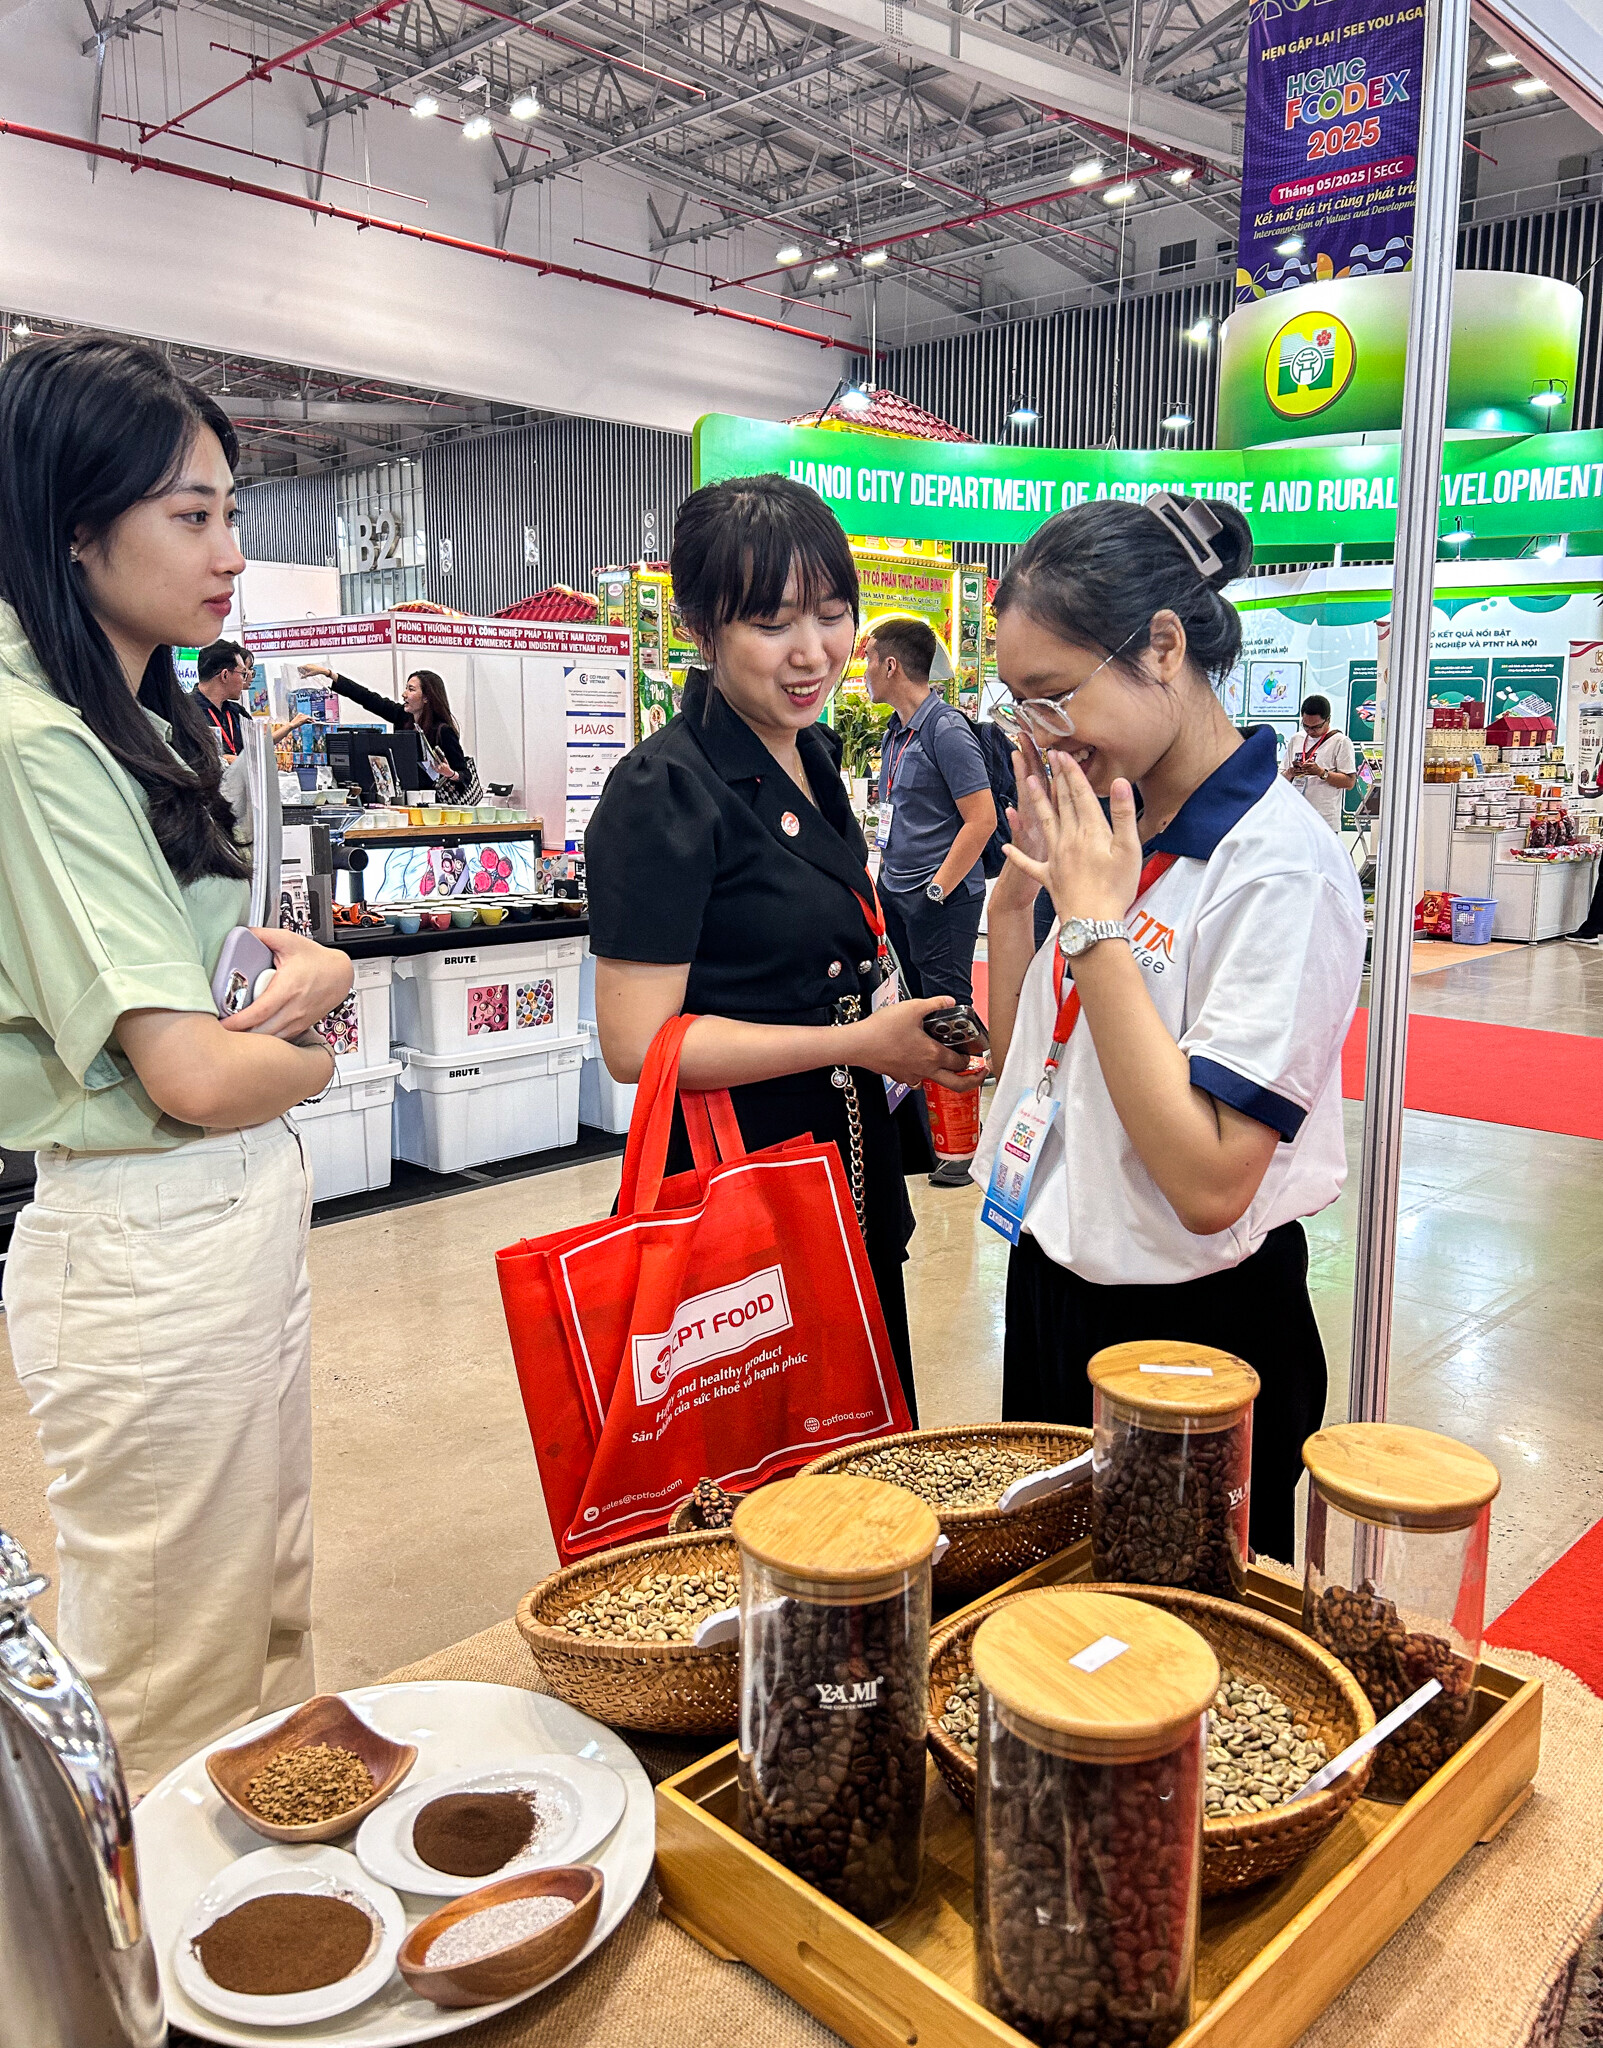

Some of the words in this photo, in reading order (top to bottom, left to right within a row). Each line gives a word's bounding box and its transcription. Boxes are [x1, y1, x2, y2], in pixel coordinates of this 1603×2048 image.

[1262, 44, 1285, 61] HẸN
[1288, 37, 1313, 52] GẶP
[1316, 32, 1335, 47] LẠI
[1343, 21, 1365, 38] SEE
[1368, 14, 1394, 34] YOU
[1286, 57, 1366, 99] HCMC
[1307, 116, 1380, 161] 2025
[1278, 183, 1314, 200] Tháng
[1316, 172, 1365, 191] 05/2025
[1374, 161, 1404, 178] SECC
[1254, 210, 1273, 227] Kết
[1296, 204, 1314, 220] giá
[1334, 194, 1363, 209] cùng
[1366, 185, 1395, 203] phát
[1254, 219, 1313, 240] Interconnection
[1314, 216, 1324, 227] of
[1326, 211, 1351, 224] Values
[1353, 208, 1370, 219] and
[790, 460, 852, 500] HANOI
[858, 468, 905, 504] CITY
[910, 472, 1056, 512] DEPARTMENT
[1061, 481, 1090, 511] OF
[1260, 480, 1312, 512] AND
[1317, 477, 1398, 512] RURAL
[356, 510, 401, 572] B2
[863, 570, 871, 584] TY
[397, 620, 422, 632] PHÒNG
[453, 625, 466, 637] MẠI
[467, 624, 478, 636] VÀ
[479, 625, 497, 636] CÔNG
[498, 628, 523, 639] NGHIỆP
[524, 628, 541, 639] PHÁP
[542, 630, 553, 642] TẠI
[554, 631, 569, 641] VIỆT
[570, 633, 584, 642] NAM
[586, 633, 607, 644] (CCIFV)
[398, 634, 426, 644] FRENCH
[428, 635, 462, 646] CHAMBER
[464, 638, 473, 646] OF
[475, 638, 512, 649] COMMERCE
[514, 640, 526, 649] AND
[528, 641, 560, 651] INDUSTRY
[561, 642, 567, 650] IN
[569, 643, 596, 653] VIETNAM
[597, 644, 618, 654] (CCIFV)
[620, 641, 628, 649] 94
[1435, 641, 1466, 650] NGHIỆP
[1469, 640, 1481, 648] VÀ
[1506, 639, 1519, 647] HÀ
[1521, 639, 1537, 648] NỘI
[1438, 630, 1454, 638] KẾT
[1455, 629, 1473, 639] QUẢ
[1493, 629, 1511, 638] BẬT
[574, 724, 614, 735] HAVAS
[444, 955, 477, 965] BRUTE
[449, 1067, 480, 1078] BRUTE
[669, 1316, 706, 1354] CPT
[712, 1293, 774, 1334] FOOD
[677, 1378, 696, 1399] and
[700, 1367, 743, 1388] healthy
[745, 1345, 782, 1373] product
[631, 1428, 654, 1444] Sản
[674, 1400, 690, 1416] của
[693, 1392, 711, 1407] sức
[743, 1375, 753, 1388] và
[754, 1363, 779, 1381] hạnh
[782, 1352, 808, 1372] phúc
[821, 1408, 874, 1428] cptfood.com
[601, 1478, 683, 1513] sales@cptfood.com
[815, 1680, 877, 1704] YAMI
